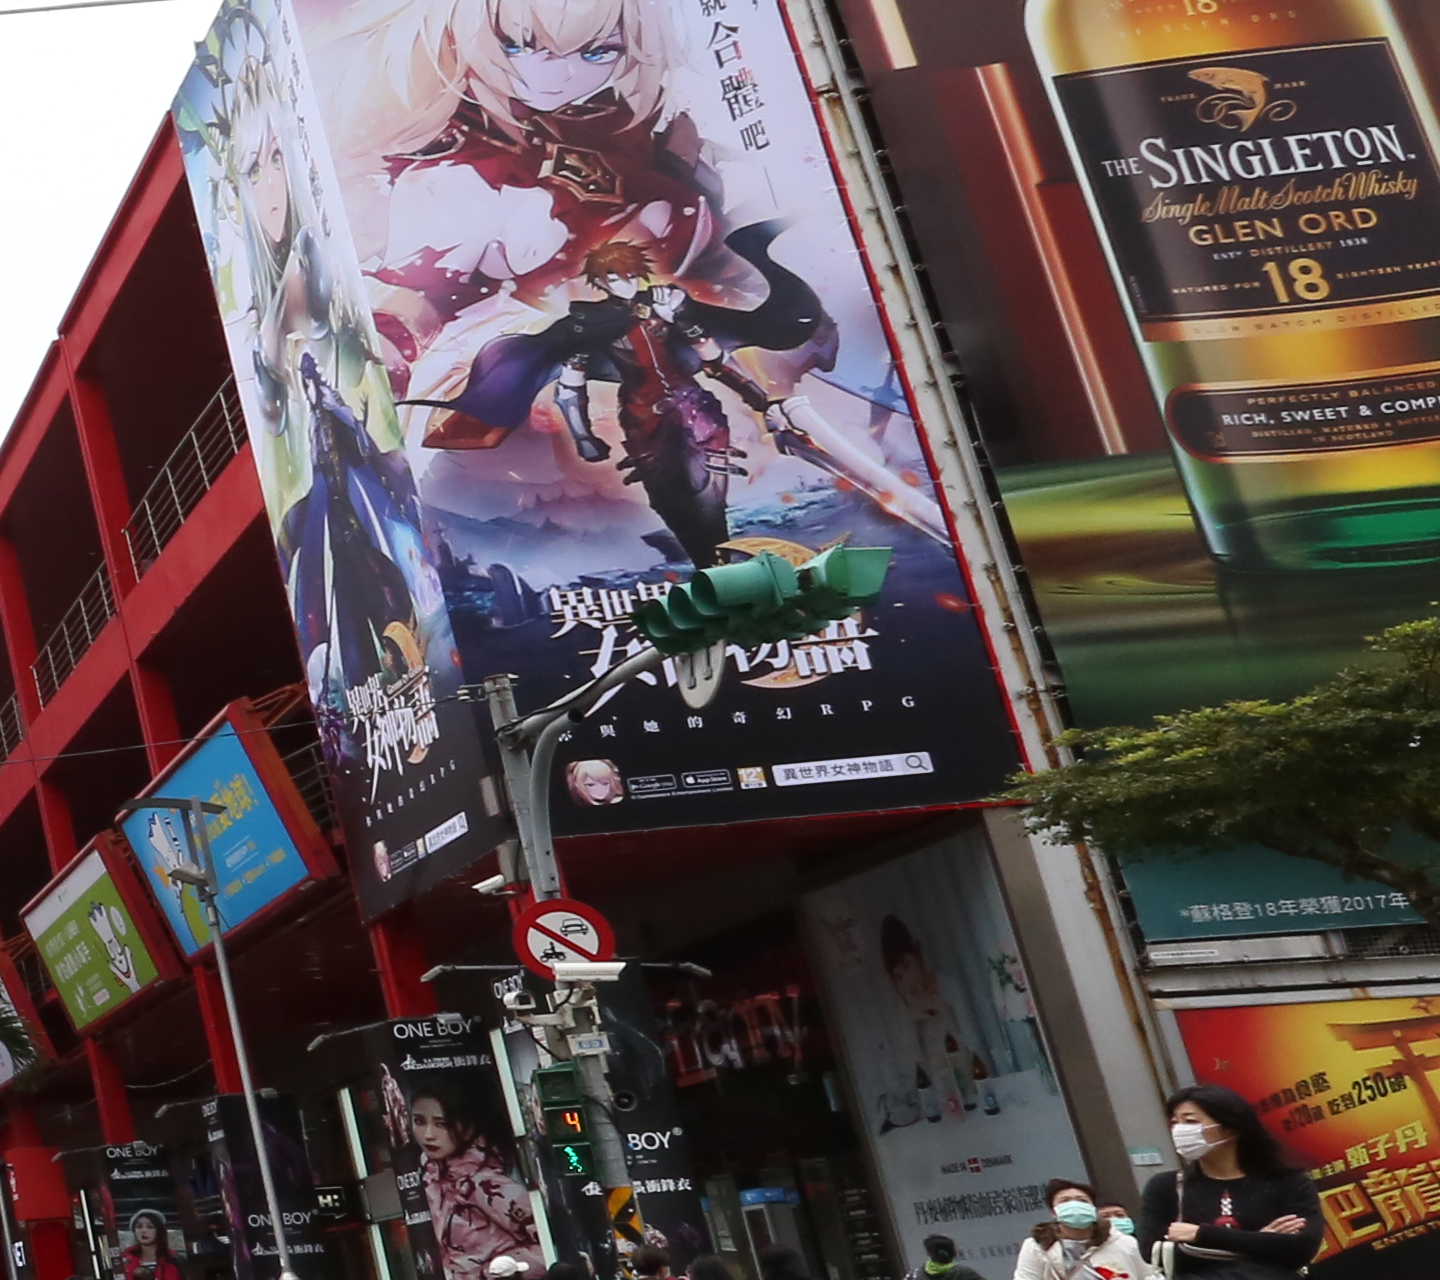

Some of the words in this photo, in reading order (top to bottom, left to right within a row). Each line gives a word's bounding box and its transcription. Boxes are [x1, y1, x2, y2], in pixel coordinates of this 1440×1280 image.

[1102, 157, 1142, 177] THE
[1139, 124, 1406, 189] SINGLETON
[1142, 192, 1213, 225] Single
[1210, 185, 1269, 217] Malt
[1267, 178, 1346, 209] Scotch
[1341, 170, 1418, 200] Whisky
[1189, 217, 1284, 246] GLEN
[1299, 207, 1378, 235] ORD
[1262, 257, 1331, 304] 18
[1247, 391, 1340, 406] PERFECTLY
[1348, 381, 1436, 399] BALANCED
[1221, 414, 1275, 426] RICH,
[1280, 406, 1349, 423] SWEET
[1359, 405, 1373, 417] &
[782, 760, 895, 782] 異世界女神物語
[393, 1022, 434, 1039] ONE
[436, 1018, 472, 1035] BOY
[564, 1111, 581, 1133] 4
[627, 1130, 672, 1151] BOY
[1344, 1120, 1428, 1169] 甄子丹
[106, 1147, 133, 1158] ONE
[248, 1214, 273, 1227] ON
[282, 1212, 312, 1225] BOY
[1372, 1224, 1427, 1251] ENTER
